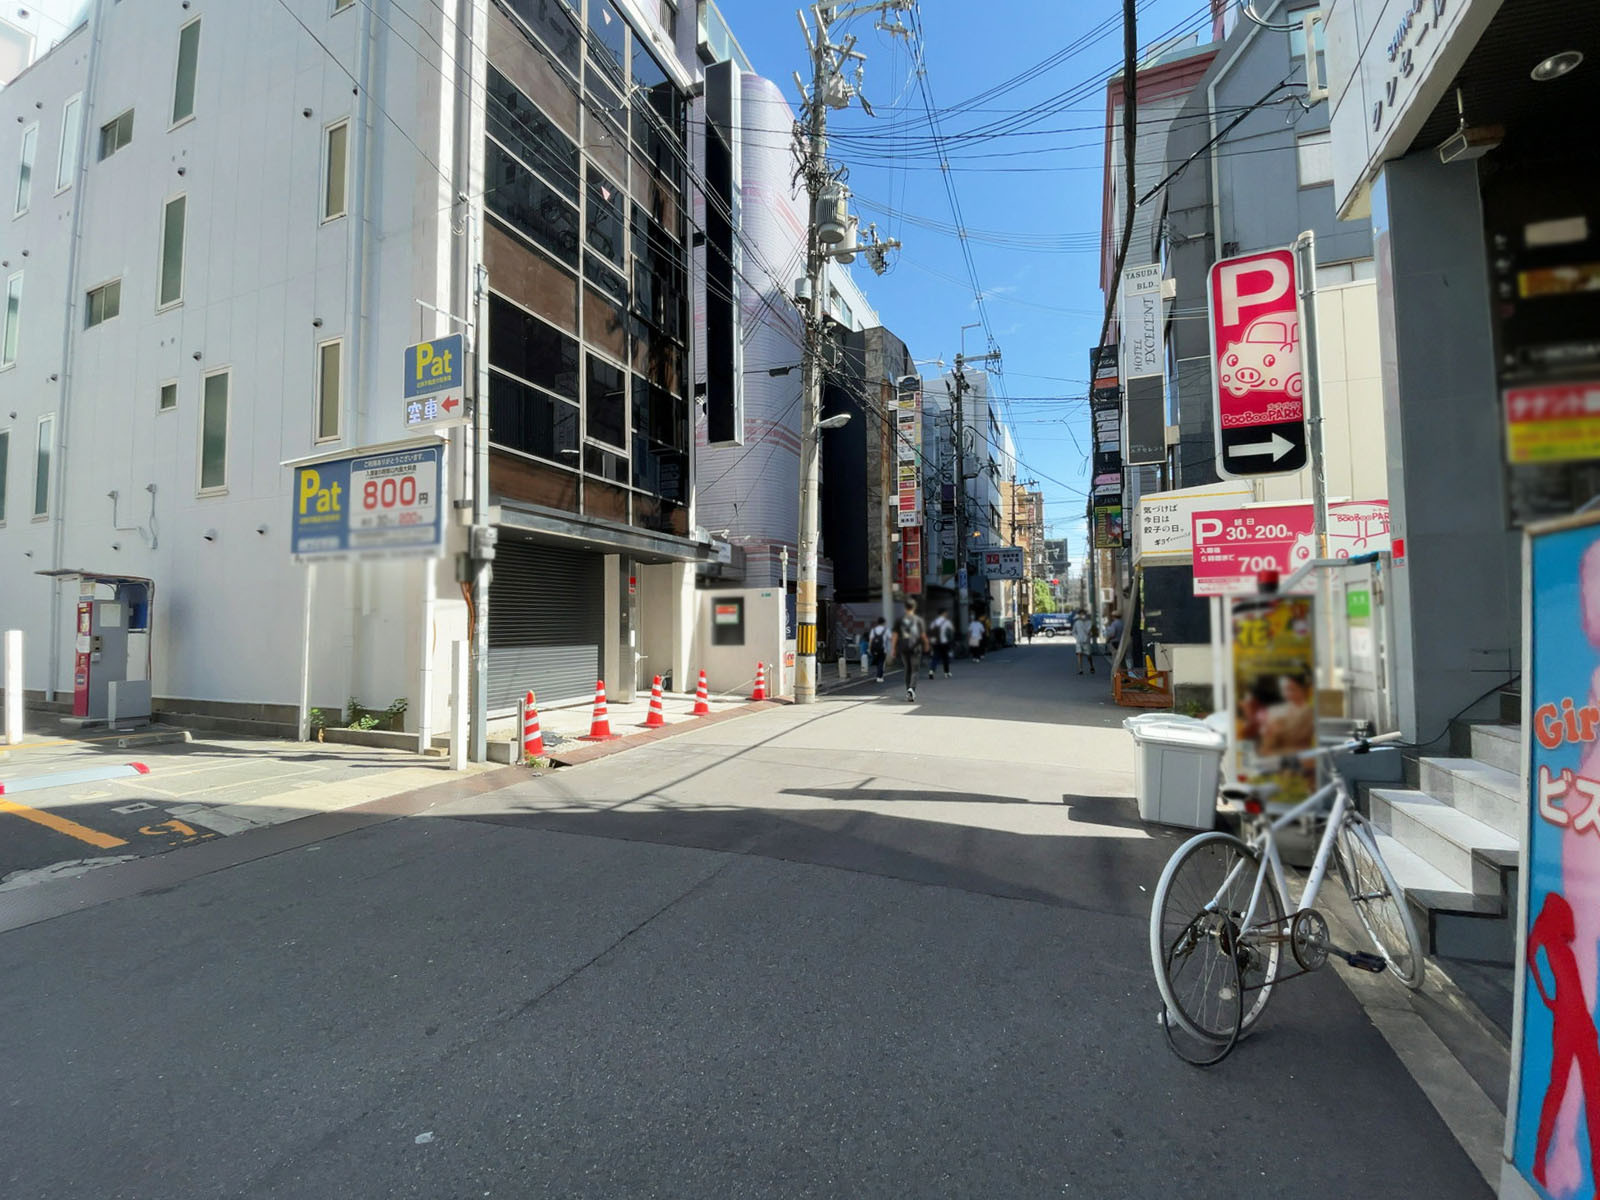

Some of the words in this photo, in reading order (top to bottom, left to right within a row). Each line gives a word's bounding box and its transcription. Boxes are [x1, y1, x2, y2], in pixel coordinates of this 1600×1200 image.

[1125, 269, 1158, 280] YASUDA
[1220, 258, 1290, 327] P
[1143, 297, 1156, 365] EXCELLENT
[416, 342, 452, 380] Pat
[1133, 339, 1144, 373] HOTEL
[408, 398, 438, 424] 空車
[1222, 406, 1302, 426] BooBooPARK
[299, 468, 342, 515] Pat
[1143, 504, 1178, 514] 気づけば
[1143, 515, 1170, 524] 今日は
[1336, 511, 1390, 523] BooBooPAR
[1195, 518, 1224, 545] P
[1534, 697, 1600, 750] Gir
